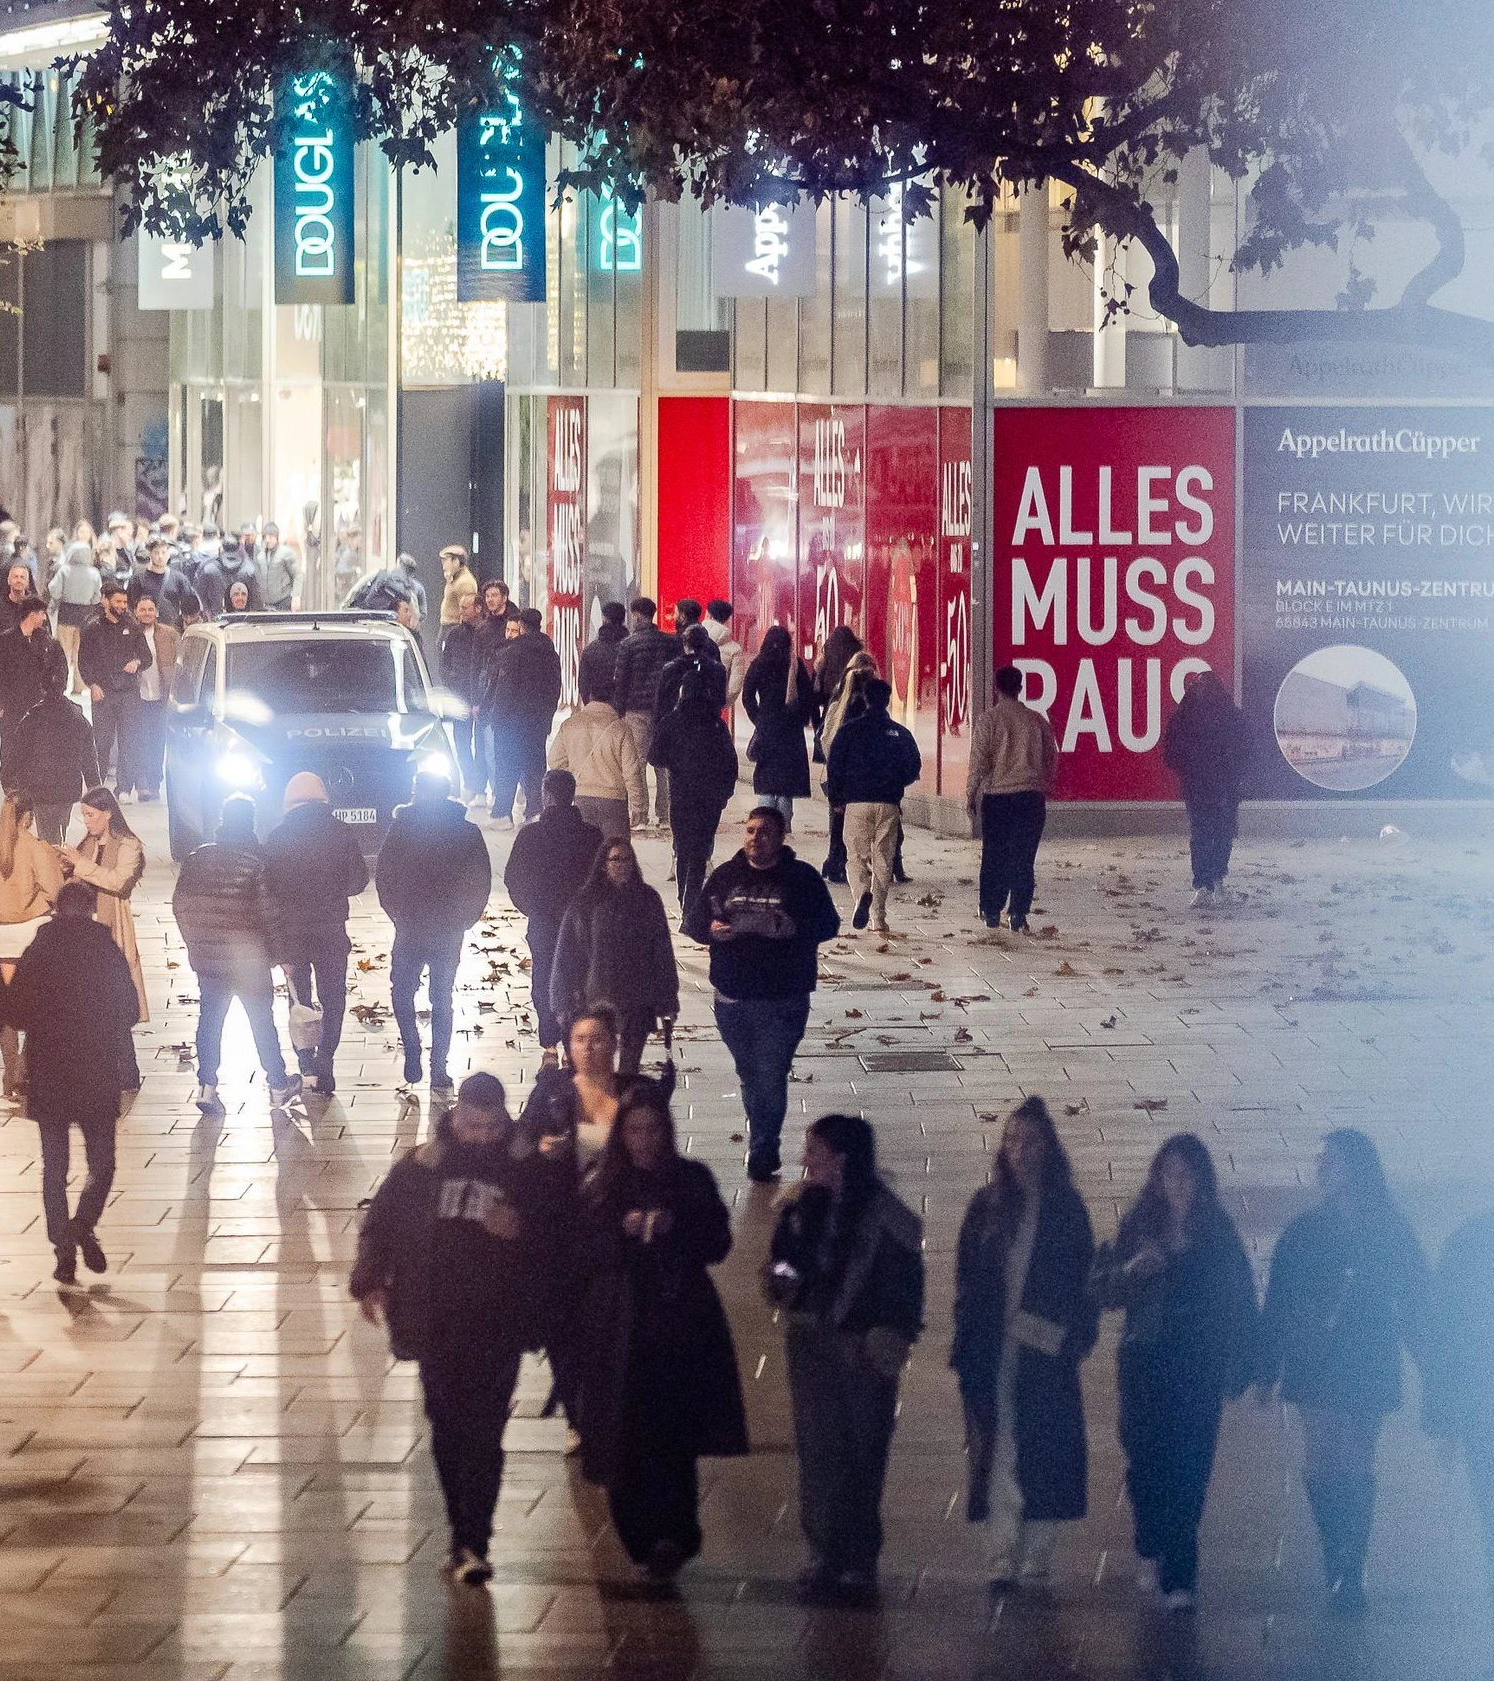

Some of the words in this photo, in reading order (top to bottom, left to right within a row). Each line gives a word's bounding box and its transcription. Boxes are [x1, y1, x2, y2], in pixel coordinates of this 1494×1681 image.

[555, 408, 581, 491] ALLES
[814, 418, 845, 508] ALLES
[1277, 428, 1481, 459] AppelrathCüpper
[942, 460, 971, 537] ALLES
[1011, 465, 1215, 546] ALLES
[1278, 491, 1436, 519] FRANKFURT,
[1442, 493, 1493, 515] WIR
[553, 502, 581, 594] MUSS
[1278, 523, 1375, 546] WEITER
[1383, 520, 1432, 546] FÜR
[1011, 556, 1216, 646] MUSS
[1276, 601, 1322, 613] BLOCK
[1336, 601, 1352, 613] IM
[286, 728, 387, 739] POLIZEI
[350, 809, 375, 821] 5184
